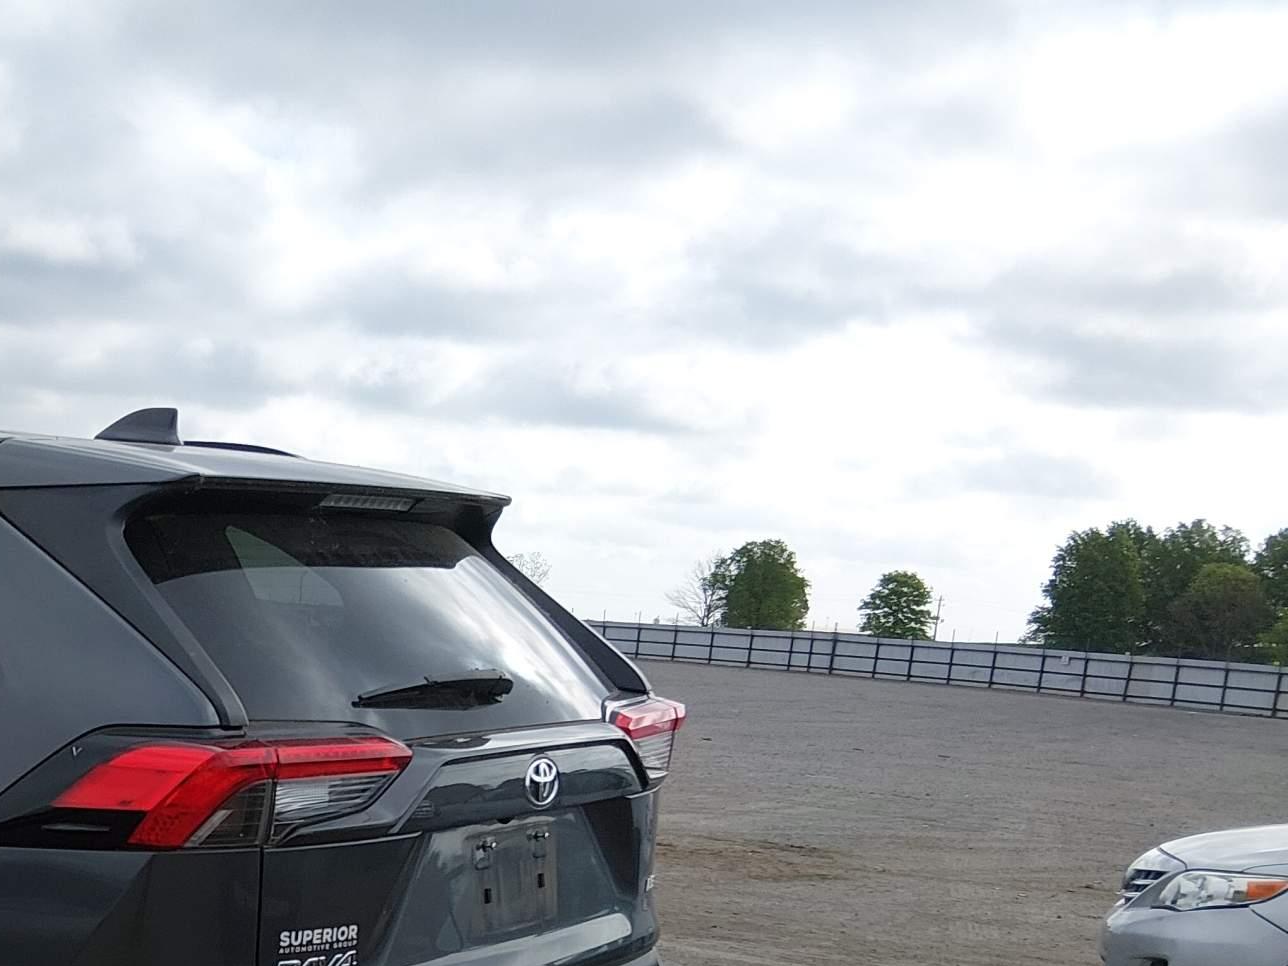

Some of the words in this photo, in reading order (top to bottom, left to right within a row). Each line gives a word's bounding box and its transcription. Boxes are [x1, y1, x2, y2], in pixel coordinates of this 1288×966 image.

[279, 925, 358, 947] SUPERIOR
[279, 944, 330, 954] AUTOMOTIVE
[333, 940, 357, 949] GROUP
